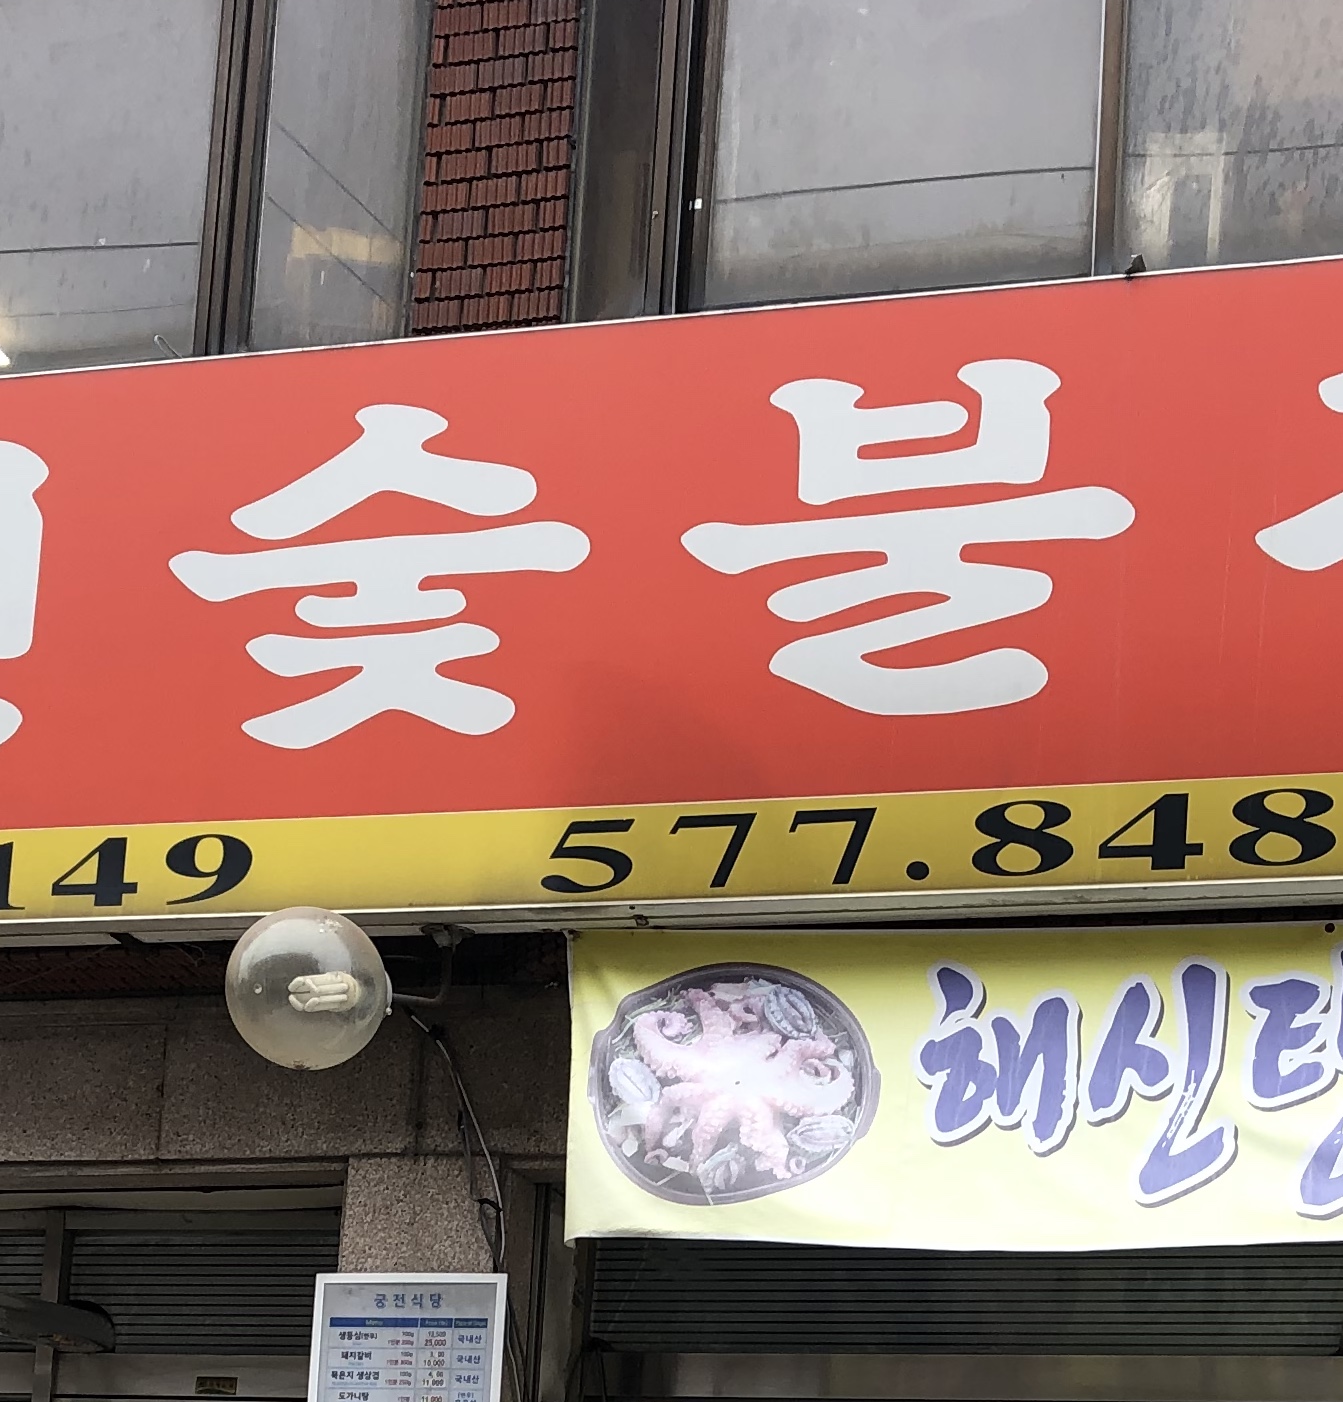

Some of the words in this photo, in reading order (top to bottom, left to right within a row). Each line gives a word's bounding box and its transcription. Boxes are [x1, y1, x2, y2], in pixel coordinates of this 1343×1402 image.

[373, 1293, 444, 1309] 궁전식당
[457, 1334, 482, 1345] 국내산
[456, 1354, 481, 1364] 국내산
[454, 1374, 480, 1384] 국내산
[338, 1391, 369, 1402] 도가니탕
